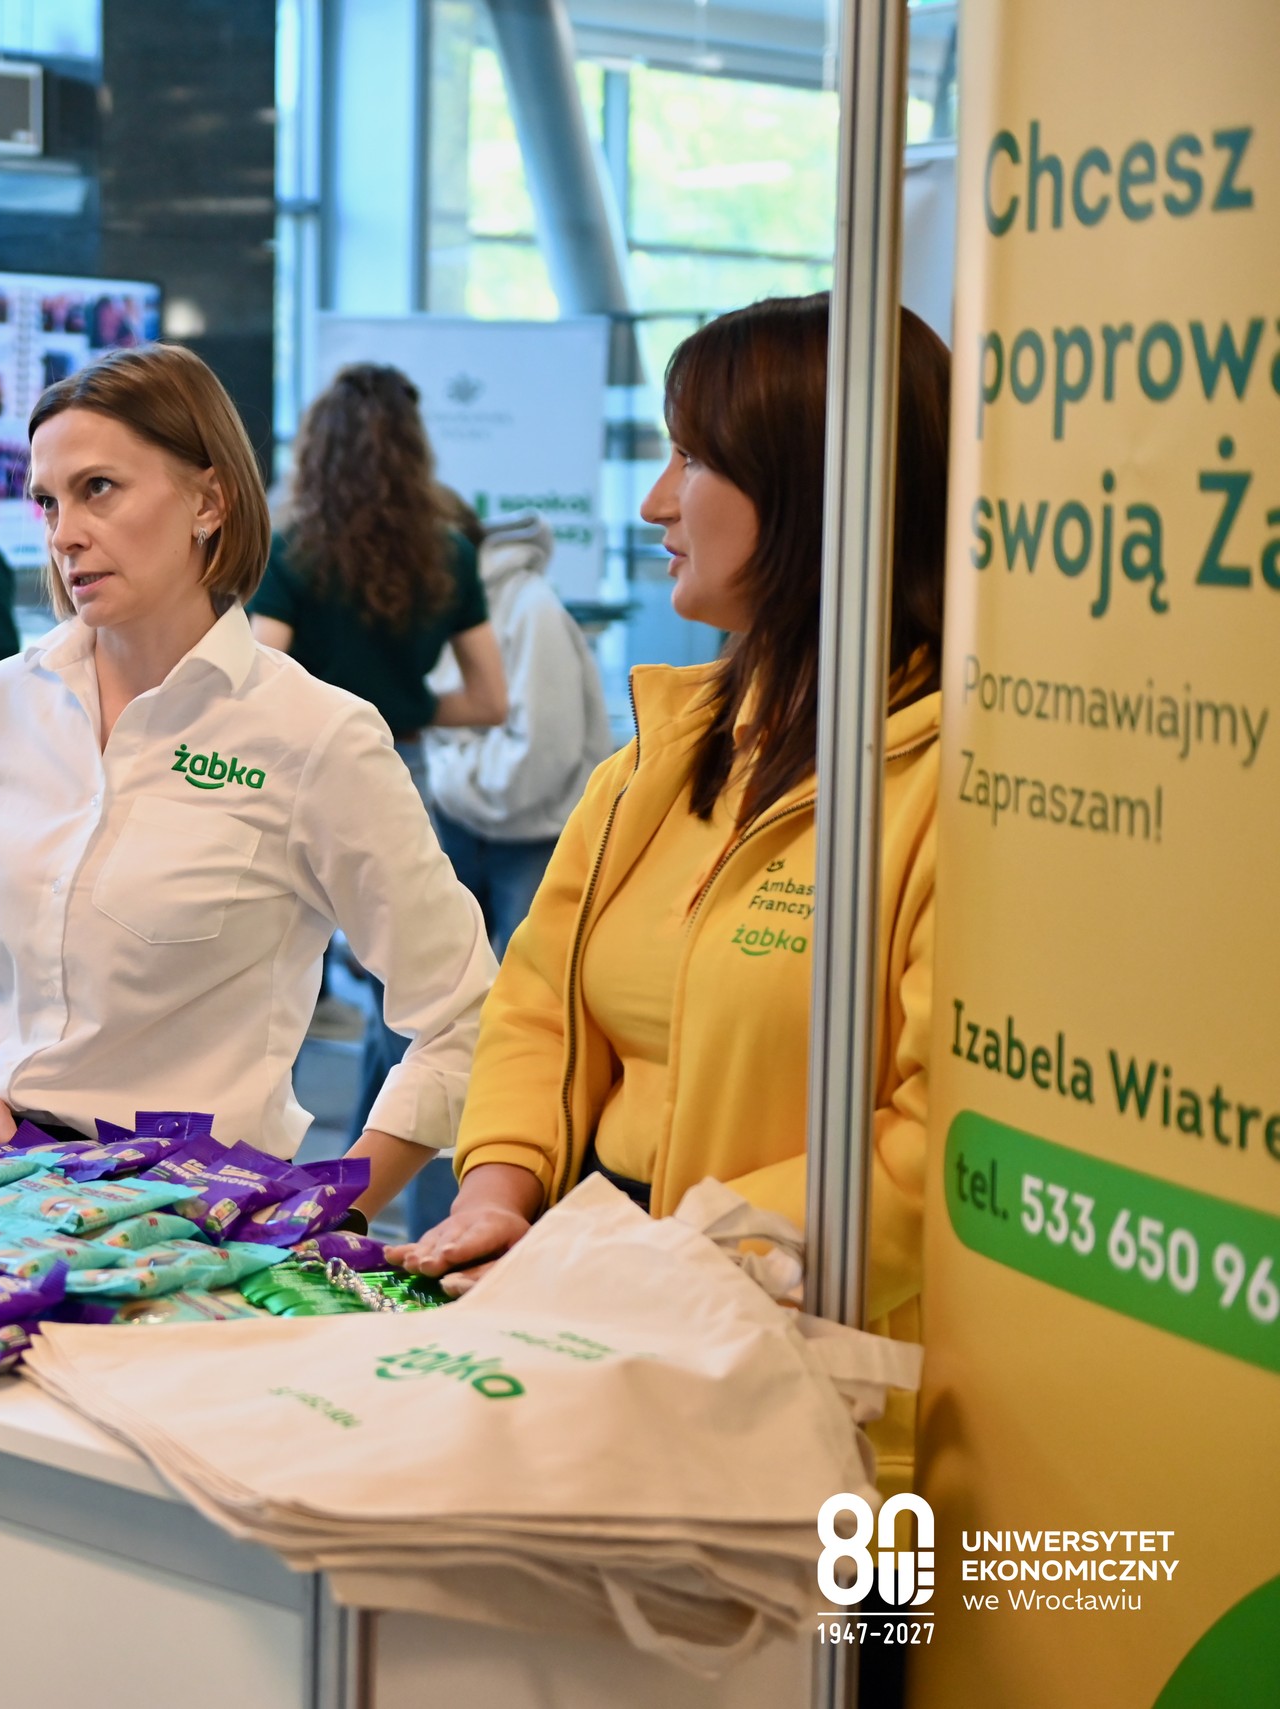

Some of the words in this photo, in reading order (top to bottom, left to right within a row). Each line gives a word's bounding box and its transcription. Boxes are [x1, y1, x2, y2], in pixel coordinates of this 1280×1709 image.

[983, 120, 1254, 237] Chcesz
[977, 316, 1280, 440] poprow
[969, 468, 1169, 618] swoją
[171, 743, 266, 789] żabka
[963, 653, 1269, 768] Porozmawiajmy
[958, 749, 1164, 844] Zapraszam!
[731, 923, 808, 955] żabka
[951, 998, 1094, 1105] Izabela
[954, 1152, 1008, 1220] tel.
[1021, 1173, 1096, 1256] 533
[1107, 1209, 1200, 1293] 650
[1212, 1242, 1280, 1324] 96
